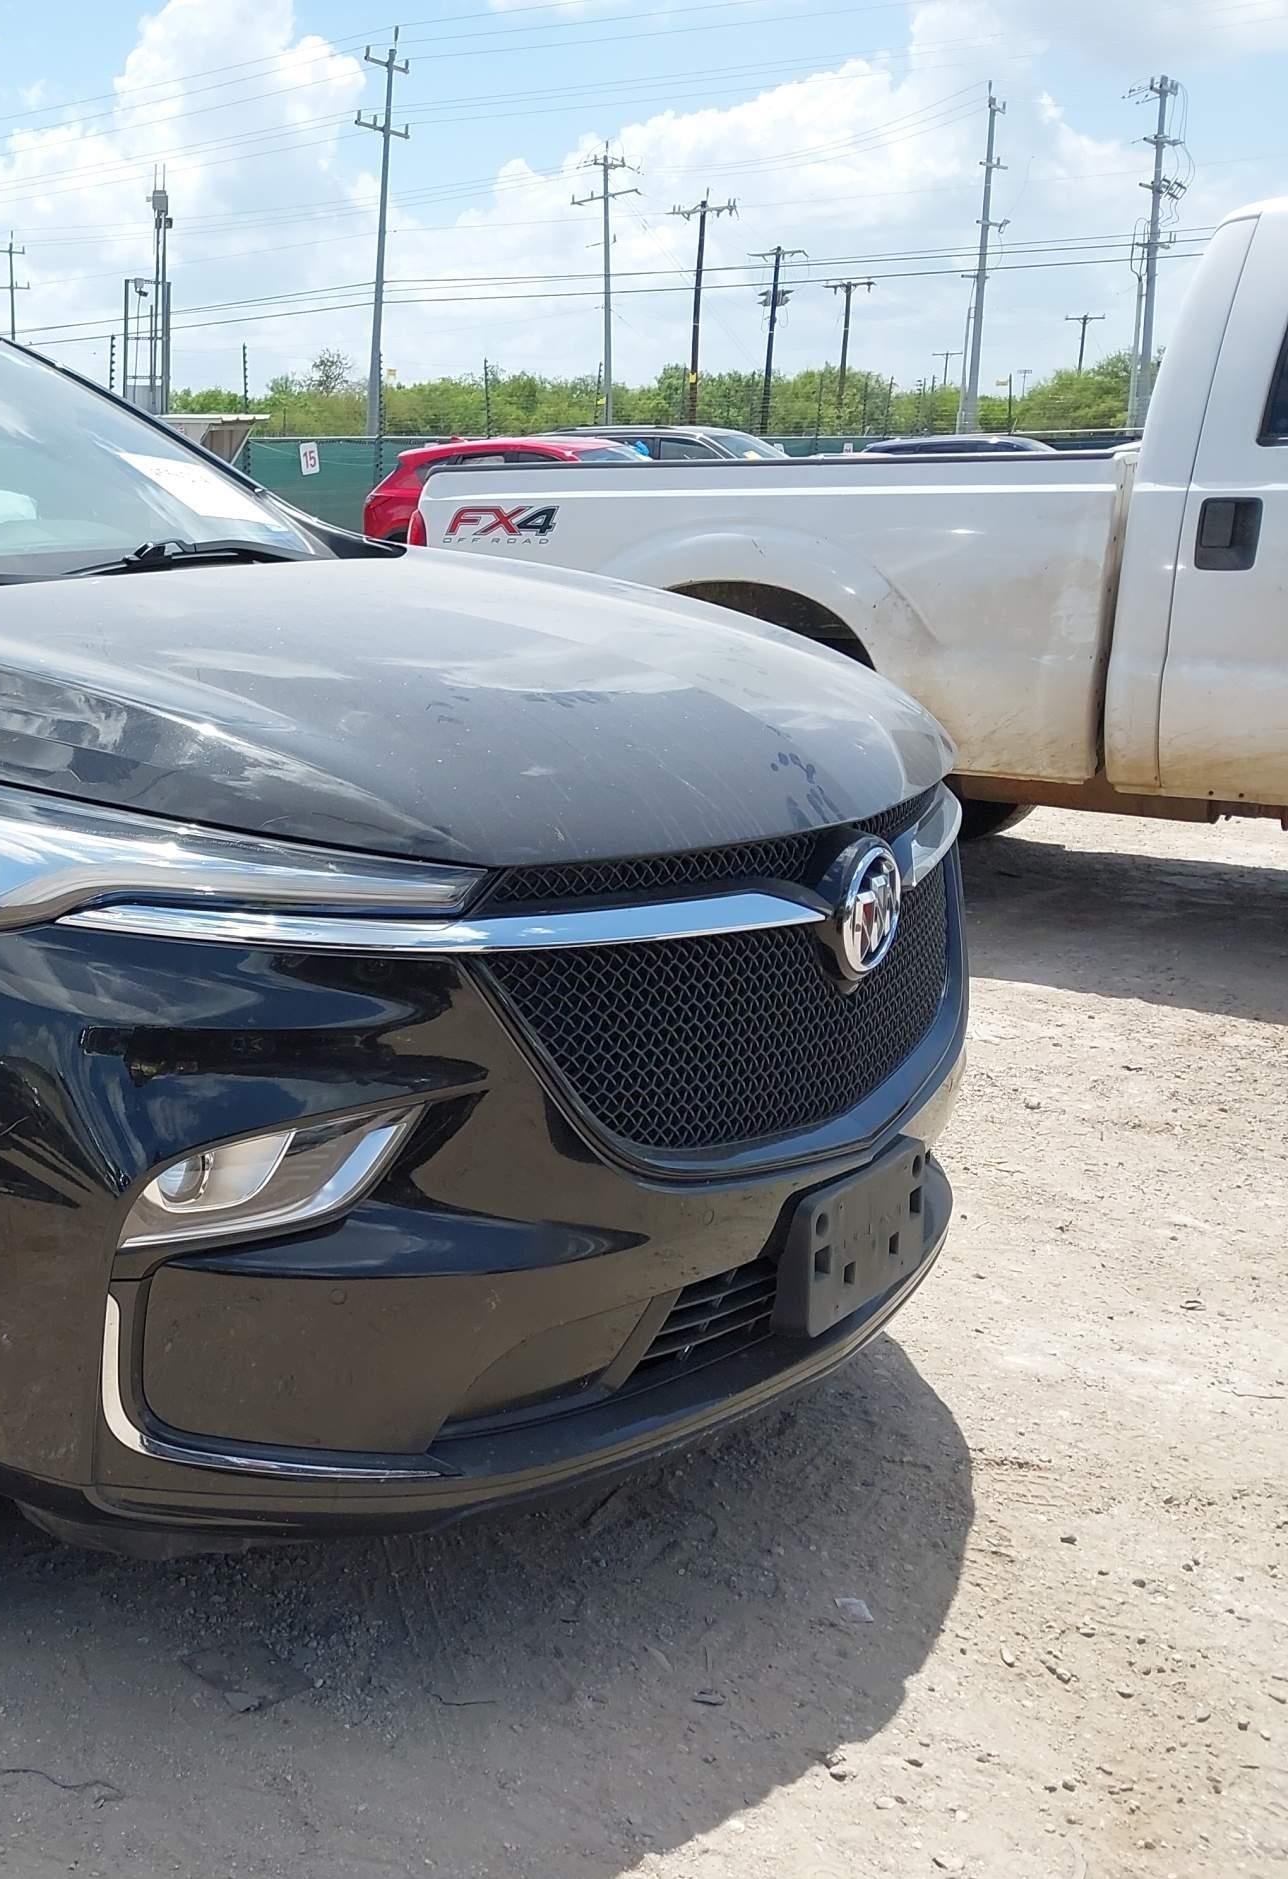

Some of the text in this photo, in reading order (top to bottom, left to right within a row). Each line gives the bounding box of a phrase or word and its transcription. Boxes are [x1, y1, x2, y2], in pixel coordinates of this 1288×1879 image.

[302, 450, 317, 469] 15
[444, 505, 560, 537] FX4
[442, 537, 550, 545] OFF ROAD
